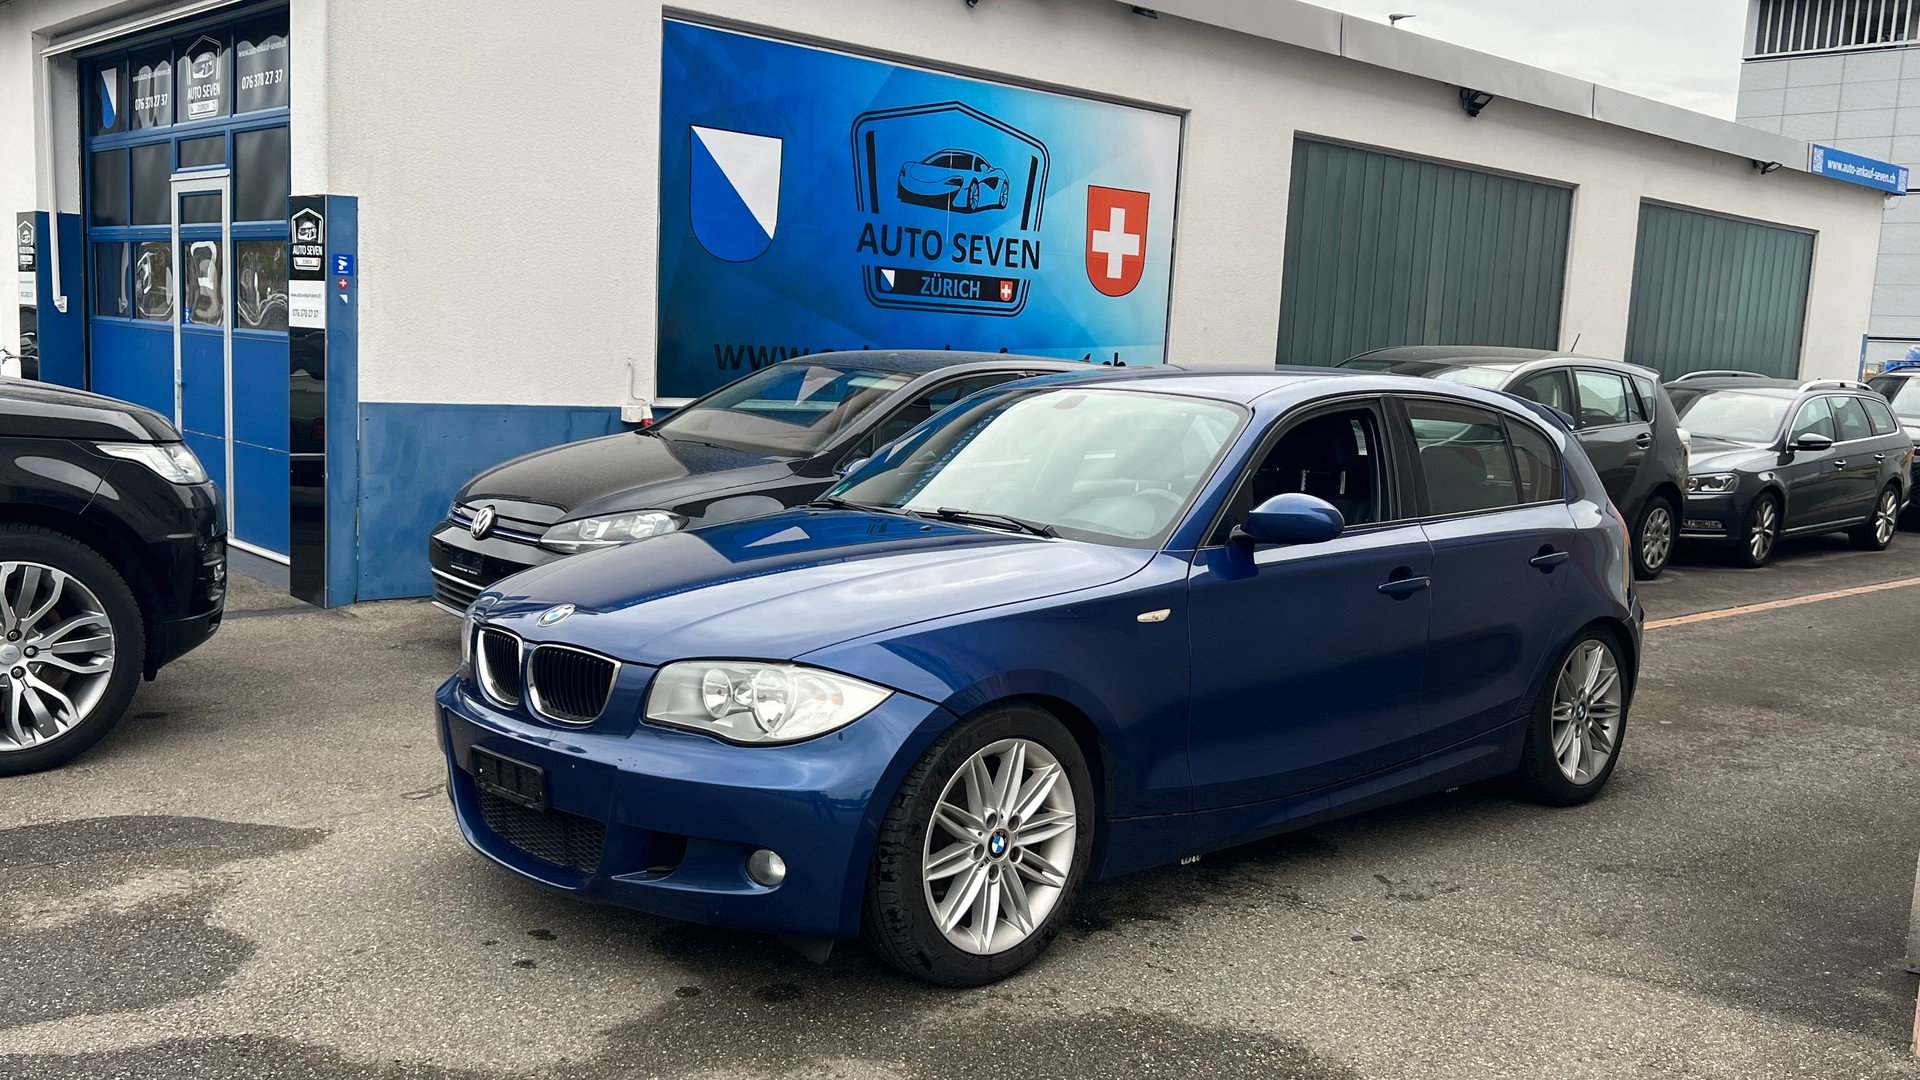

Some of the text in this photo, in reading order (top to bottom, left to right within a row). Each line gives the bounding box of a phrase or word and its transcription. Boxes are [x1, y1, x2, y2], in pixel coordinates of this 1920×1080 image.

[242, 69, 283, 90] 076 378 27 37
[161, 93, 168, 106] 37
[187, 82, 220, 101] AUTO SEVEN
[1827, 159, 1896, 185] www.auto-ankauf-seven.ch
[292, 245, 323, 256] AUTO SEVEN
[856, 222, 1041, 270] AUTO SEVEN
[920, 273, 981, 299] ZÜRICH
